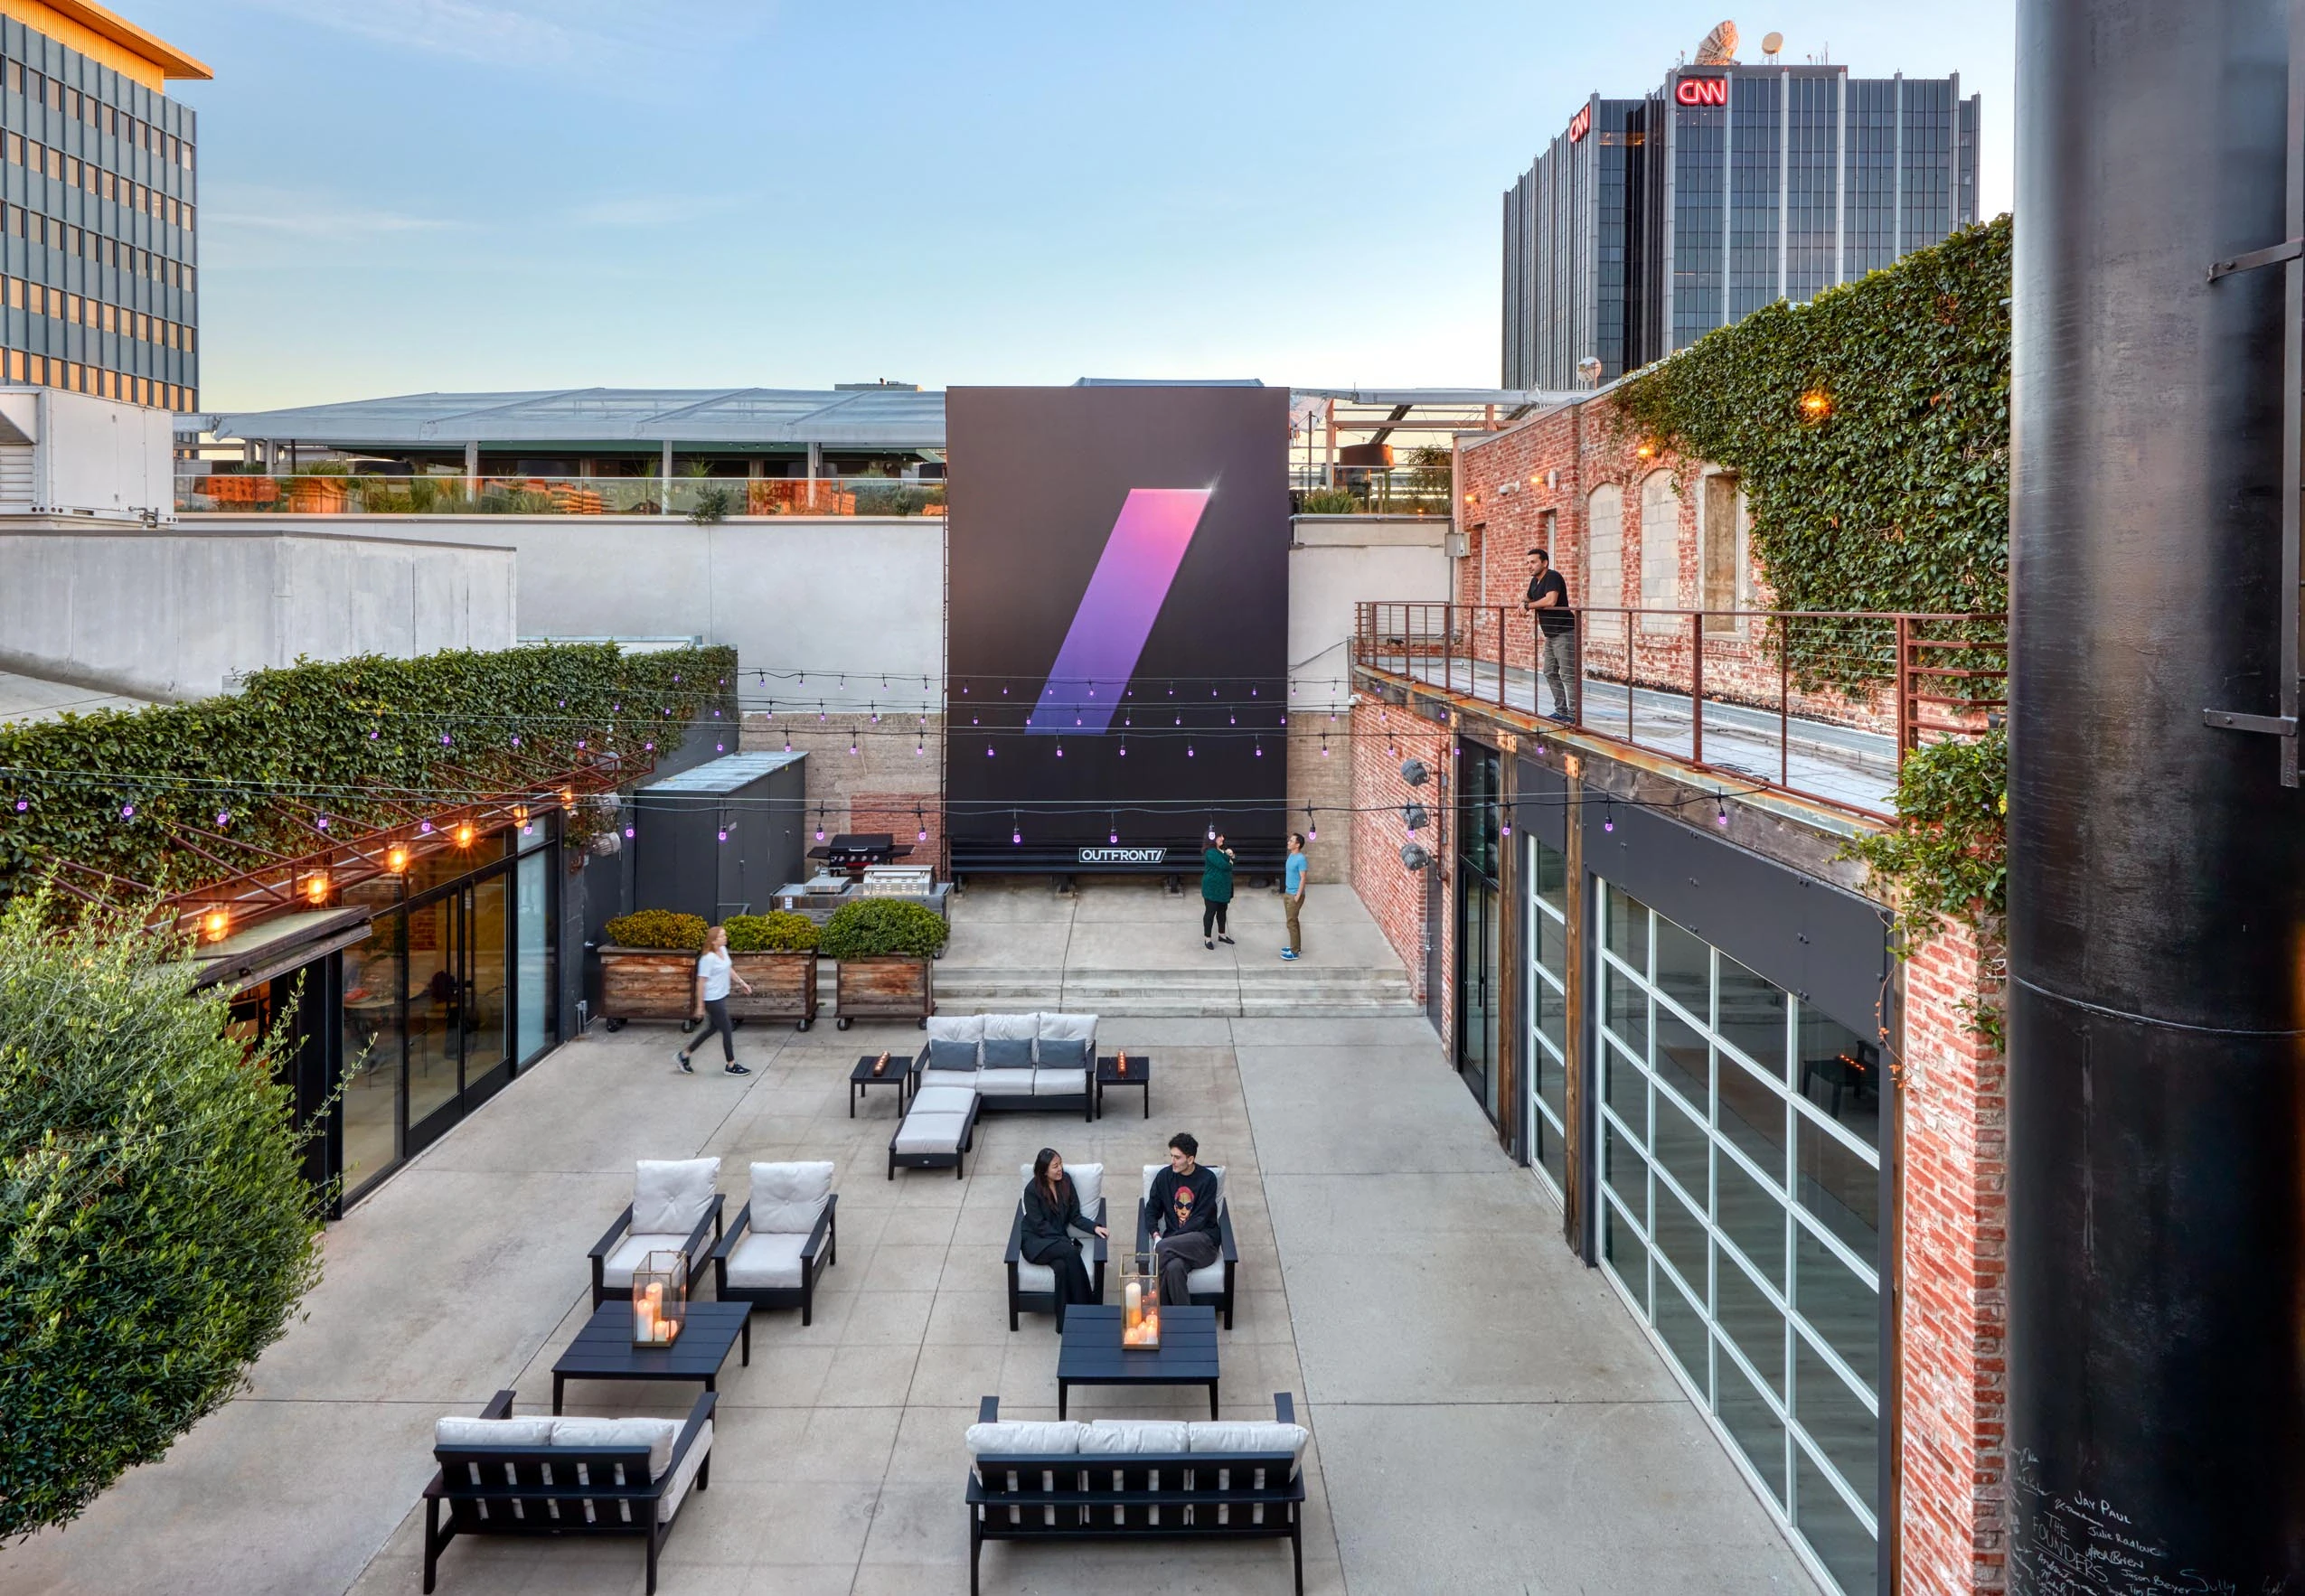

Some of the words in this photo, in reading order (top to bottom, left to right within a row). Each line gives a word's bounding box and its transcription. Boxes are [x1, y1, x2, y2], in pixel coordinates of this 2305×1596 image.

[1677, 80, 1727, 105] CNN
[1569, 104, 1590, 143] CNN
[2074, 1490, 2095, 1510] JAY
[2101, 1499, 2132, 1525] PAUL
[2044, 1510, 2070, 1541] THE
[2033, 1516, 2108, 1582] FOUNDERS
